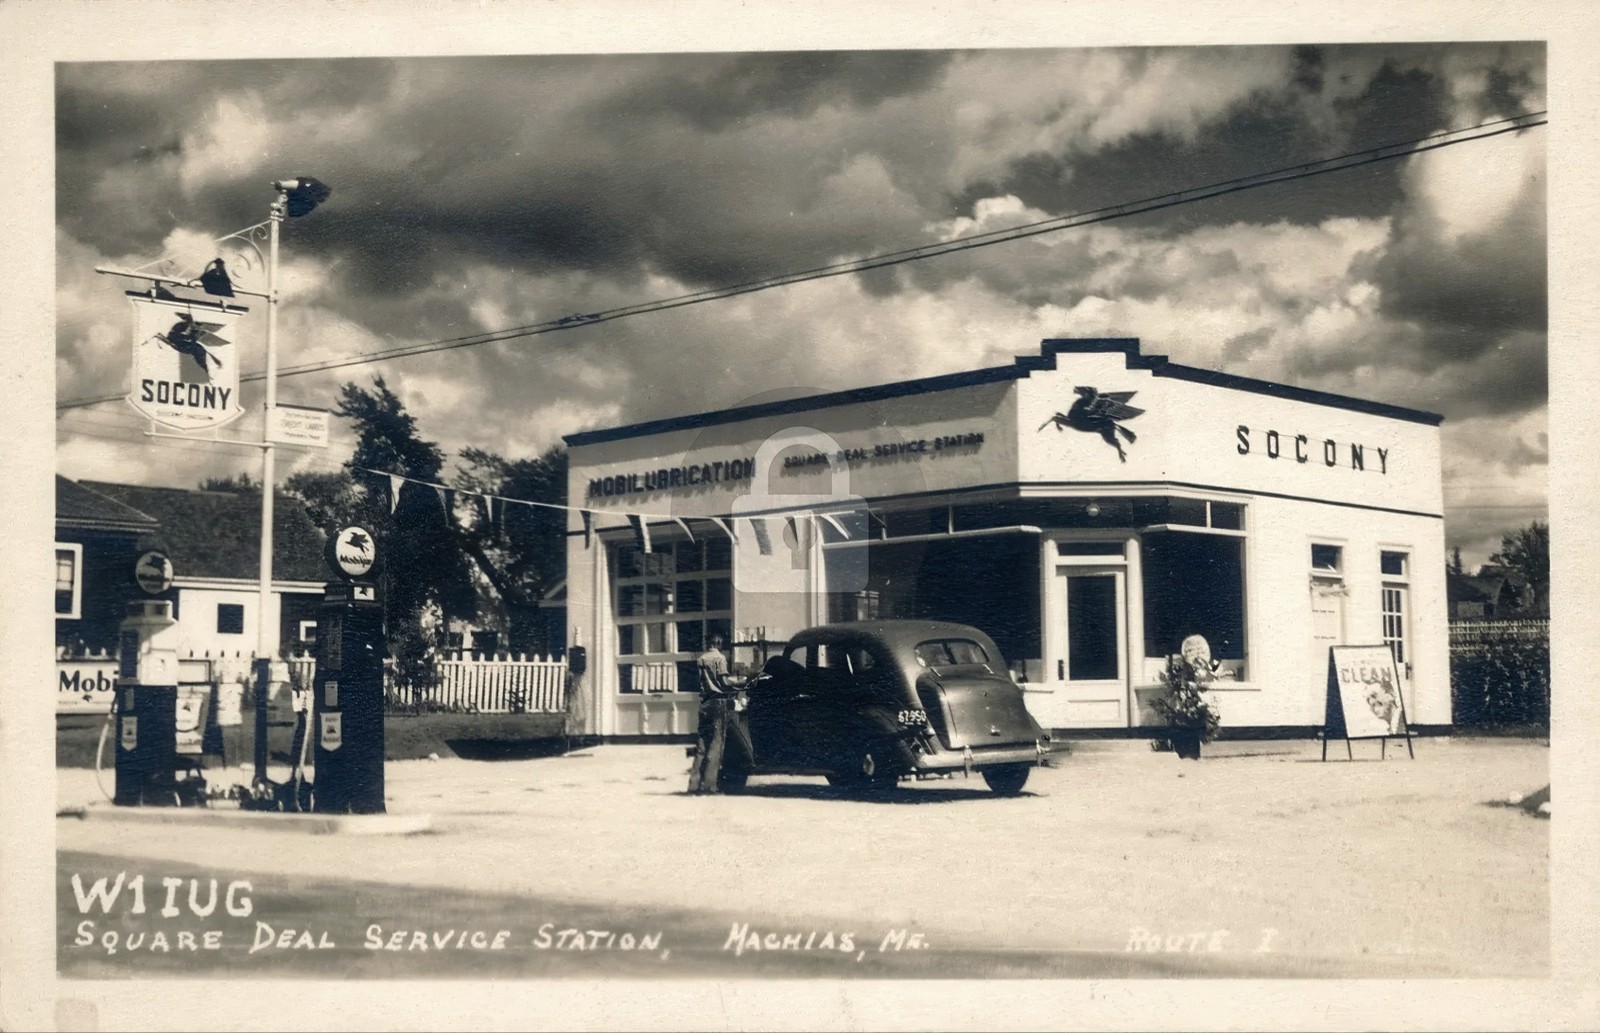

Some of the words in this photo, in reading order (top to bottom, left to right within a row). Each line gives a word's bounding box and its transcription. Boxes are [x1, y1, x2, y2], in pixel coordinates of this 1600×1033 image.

[141, 378, 232, 410] SOCONY
[874, 440, 927, 458] SERVICE
[934, 433, 985, 450] STATION
[1236, 425, 1389, 475] SOCONY
[589, 457, 756, 496] MOBILUBRICATION
[59, 670, 118, 692] Mobi
[1340, 667, 1391, 685] CLEAN
